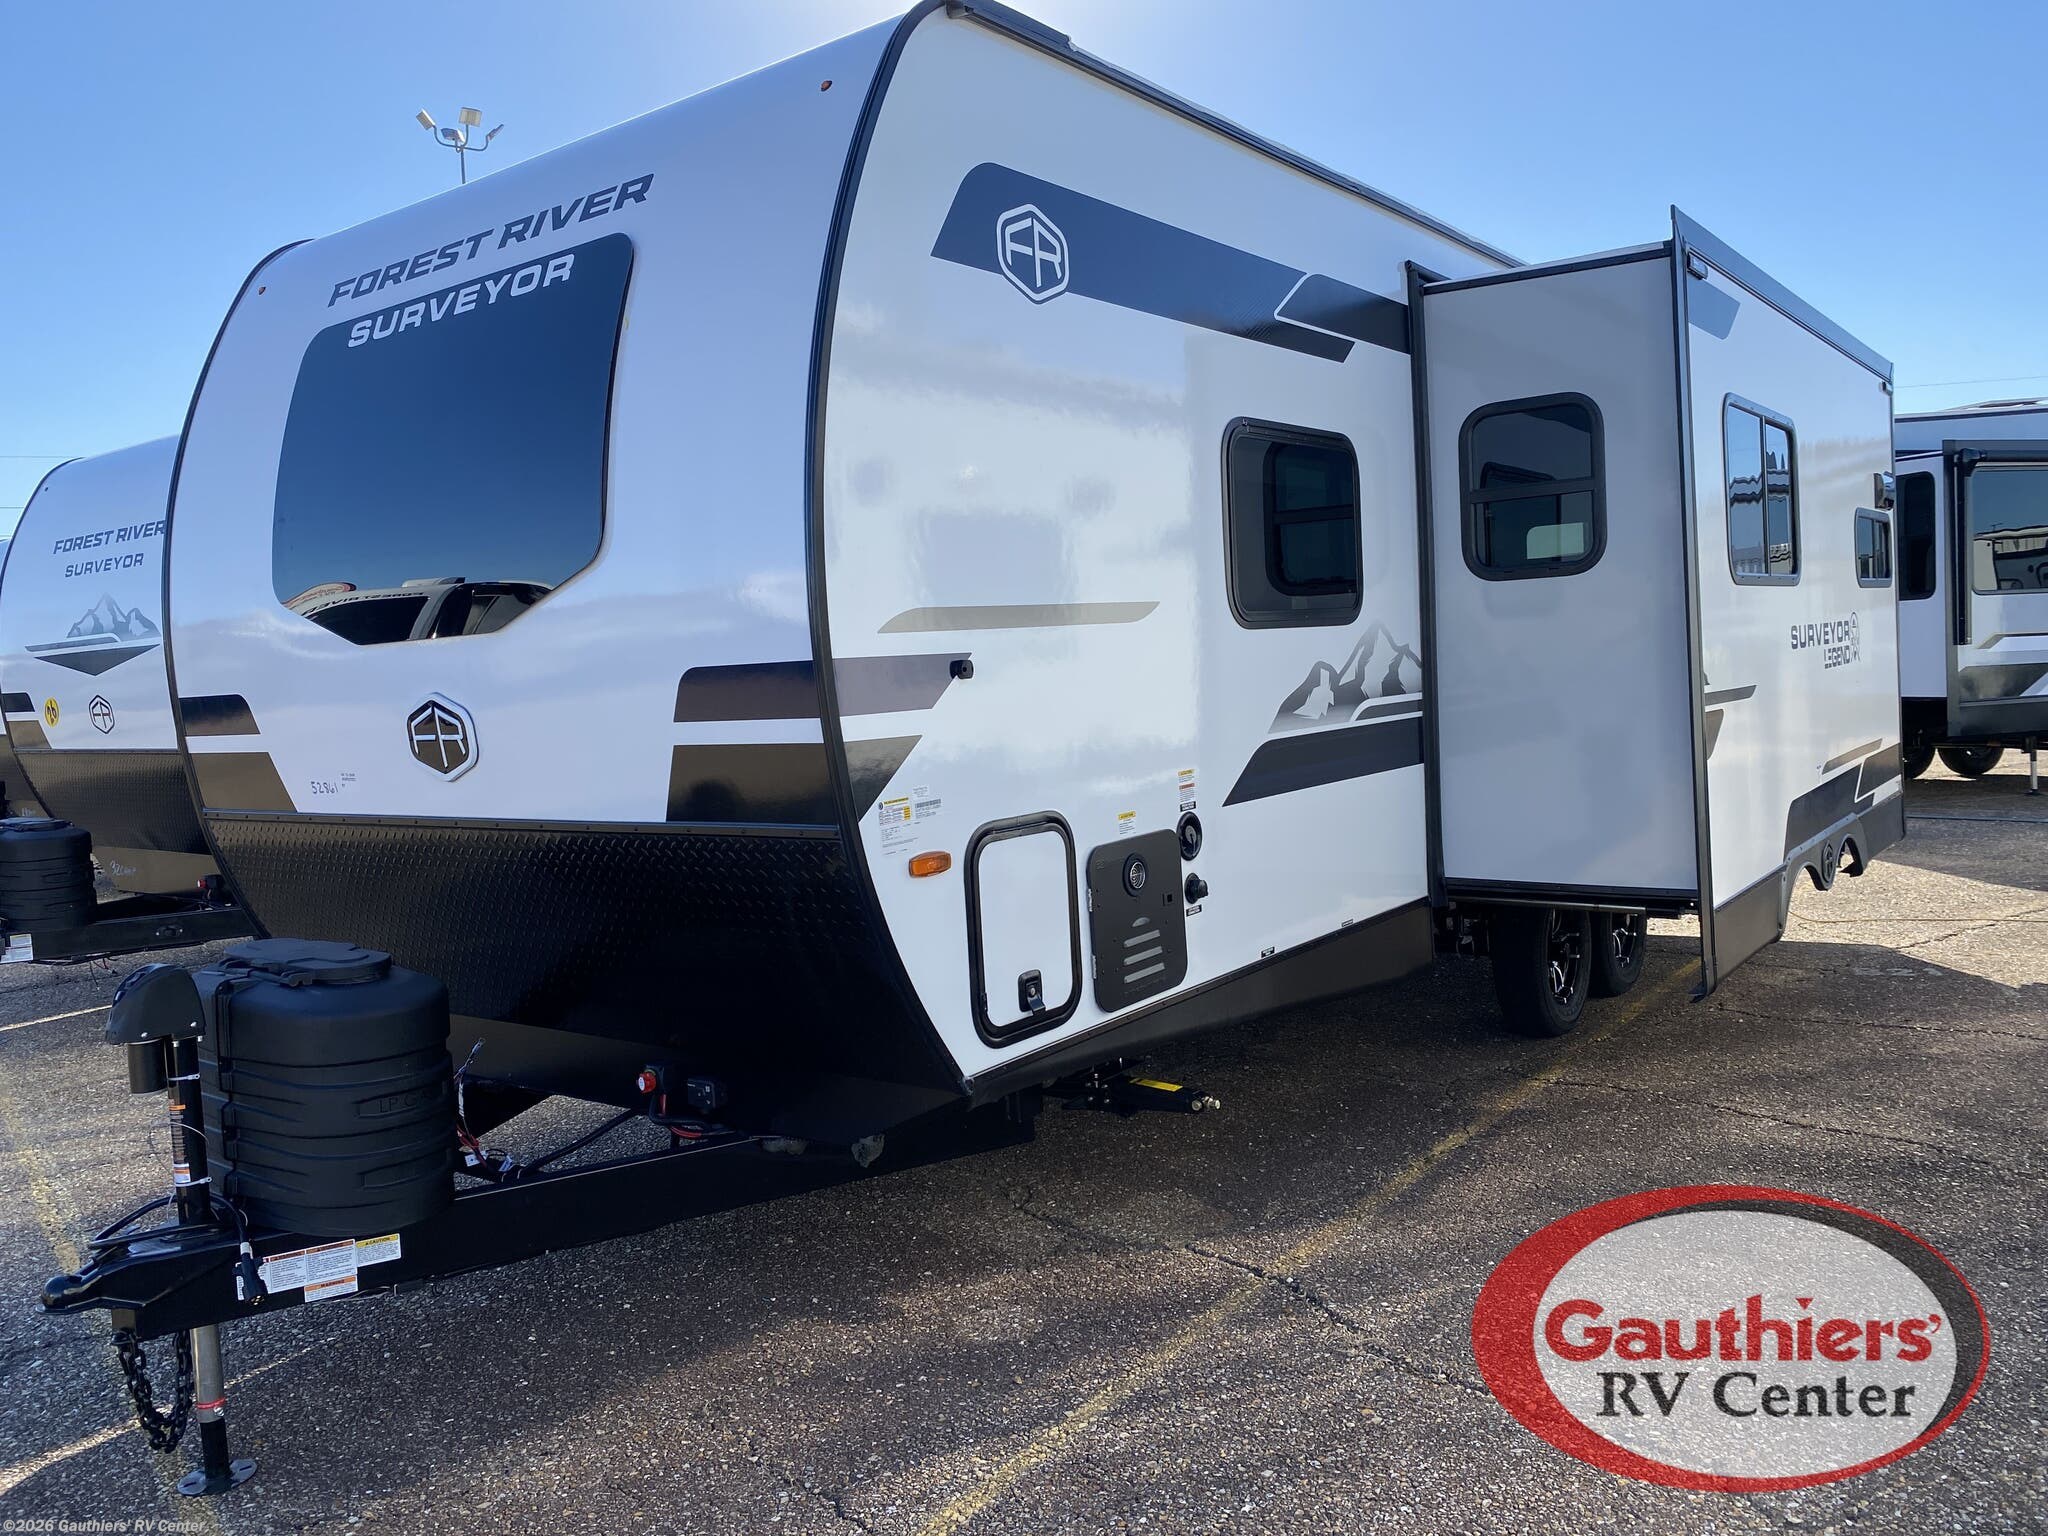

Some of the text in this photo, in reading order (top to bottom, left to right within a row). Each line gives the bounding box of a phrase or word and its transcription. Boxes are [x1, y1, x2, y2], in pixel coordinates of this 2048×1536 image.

[327, 173, 655, 308] FOREST RIVER
[347, 253, 575, 348] SURVEYOR
[53, 519, 166, 554] FOREST RIVER
[64, 552, 144, 577] SURVEYOR
[1790, 620, 1850, 649] SURVEYOR
[1823, 645, 1850, 669] LEGEND
